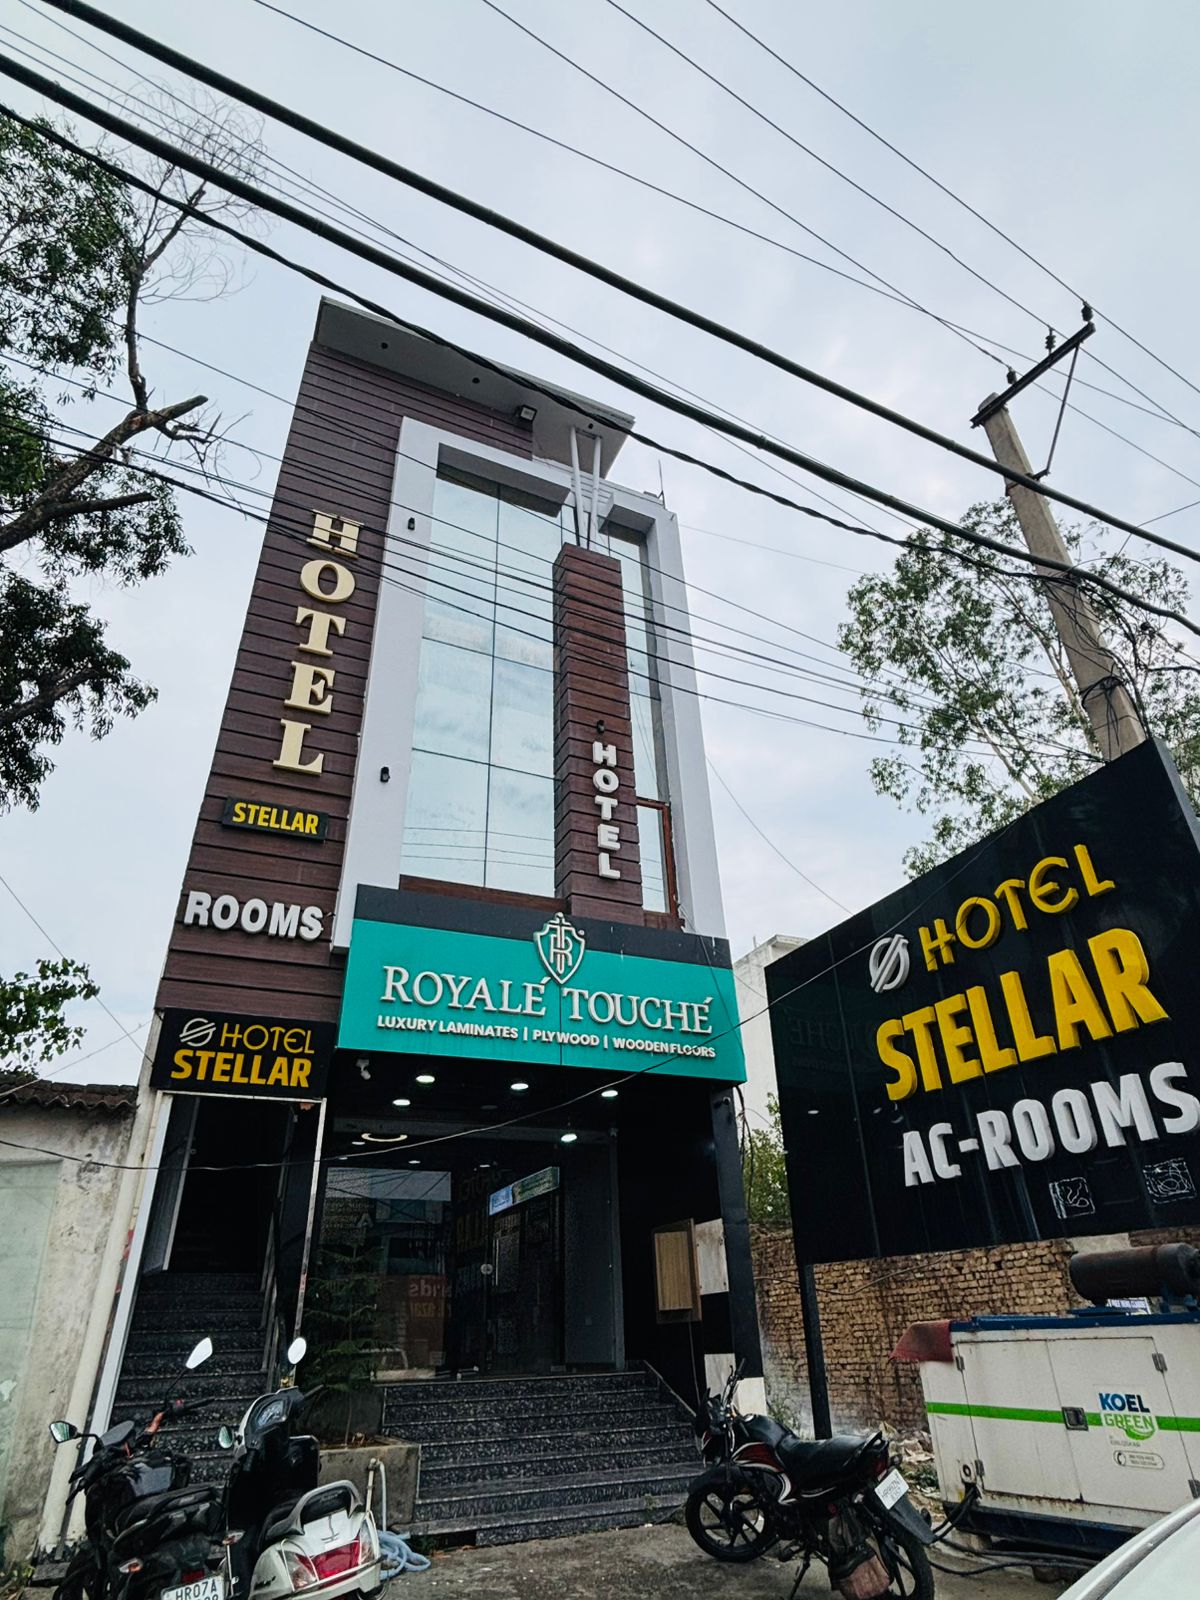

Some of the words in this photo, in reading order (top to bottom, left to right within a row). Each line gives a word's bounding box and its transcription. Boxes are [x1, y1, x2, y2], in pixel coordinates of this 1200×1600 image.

[273, 509, 364, 775] HOTEL
[232, 803, 320, 834] STELLAR
[592, 741, 620, 880] HOTEL
[183, 890, 325, 941] ROOMS
[918, 844, 1116, 972] HOTEL
[377, 1014, 437, 1034] LUXURY
[438, 1021, 519, 1040] LAMINATES
[532, 1029, 601, 1047] PLYWOOD
[875, 928, 1170, 1102] STELLAR
[220, 1022, 315, 1055] HOTEL
[170, 1049, 313, 1088] STELLAR
[903, 1061, 1200, 1188] AC-ROOMS
[1098, 1393, 1151, 1413] KOEL
[1103, 1413, 1155, 1432] GREEN
